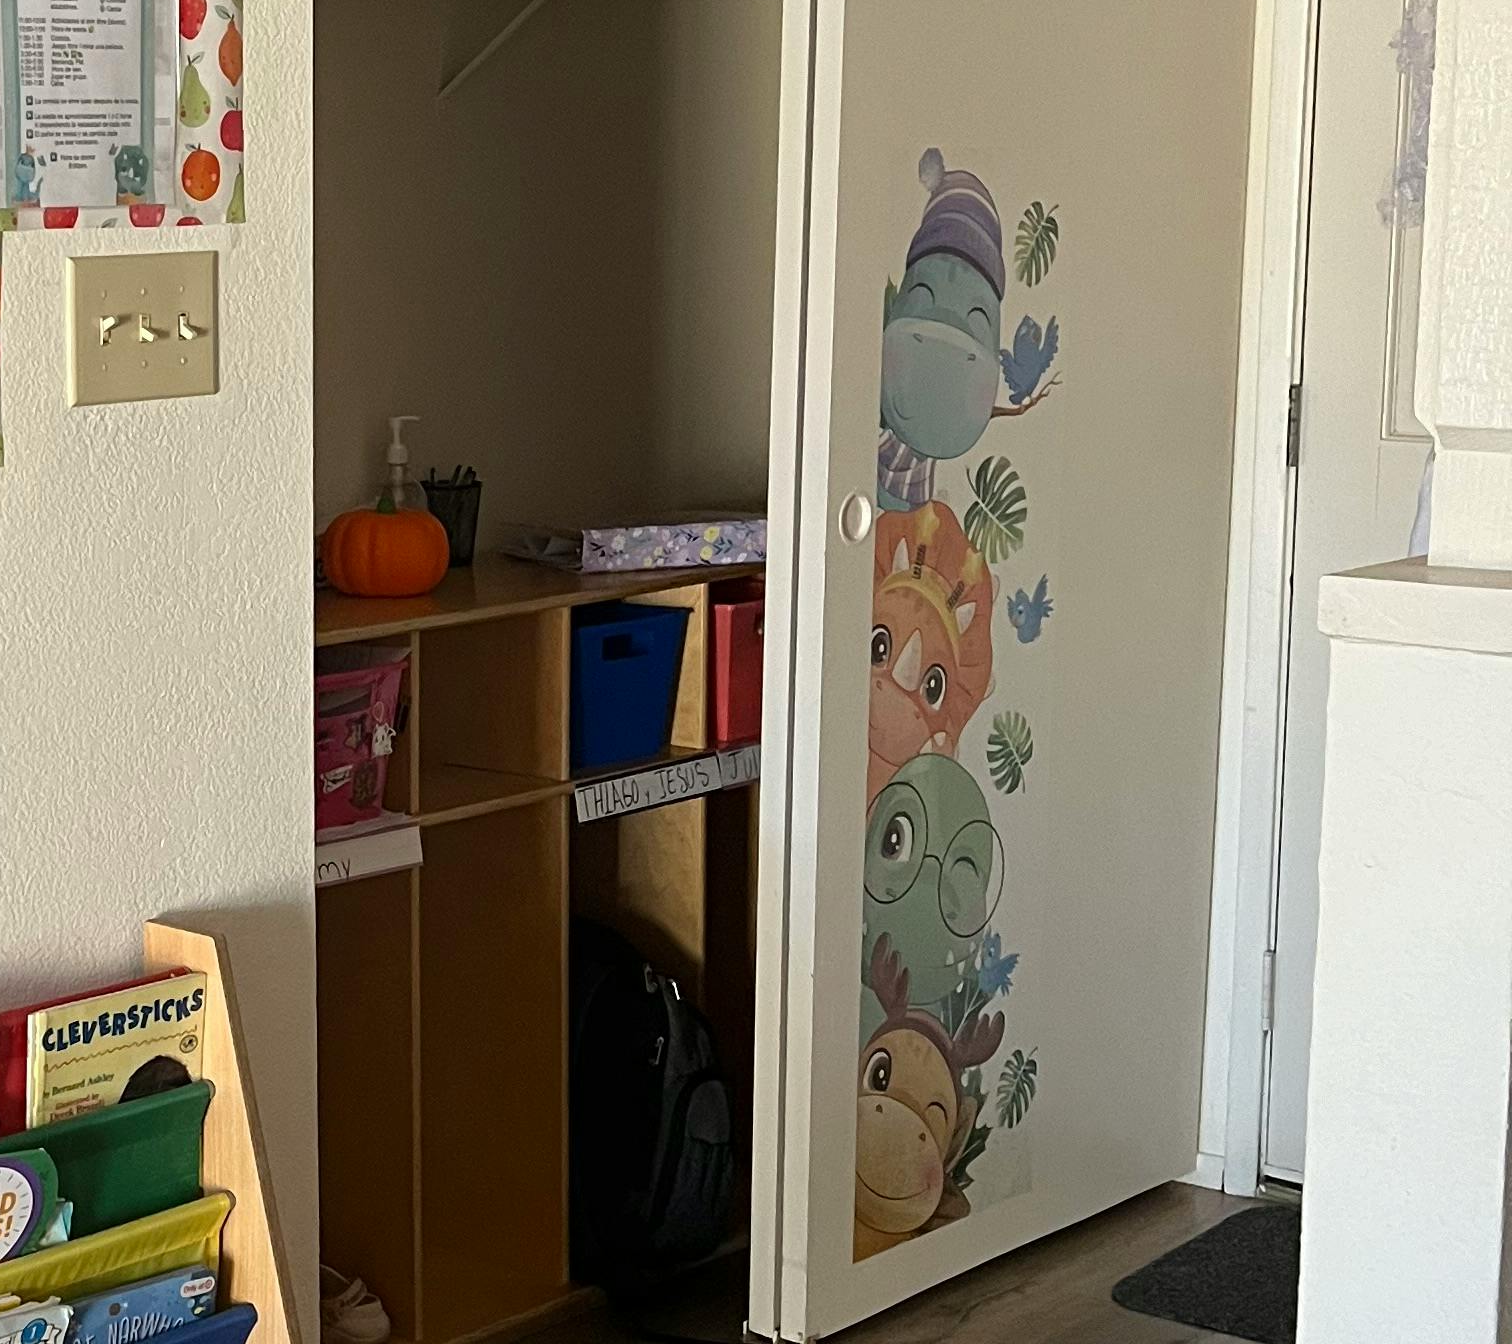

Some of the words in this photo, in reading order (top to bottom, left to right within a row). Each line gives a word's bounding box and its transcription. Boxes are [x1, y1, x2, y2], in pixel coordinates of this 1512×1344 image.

[654, 762, 710, 800] JESUS
[42, 988, 204, 1052] CLEVERSTICKS
[51, 1079, 85, 1096] Bernard
